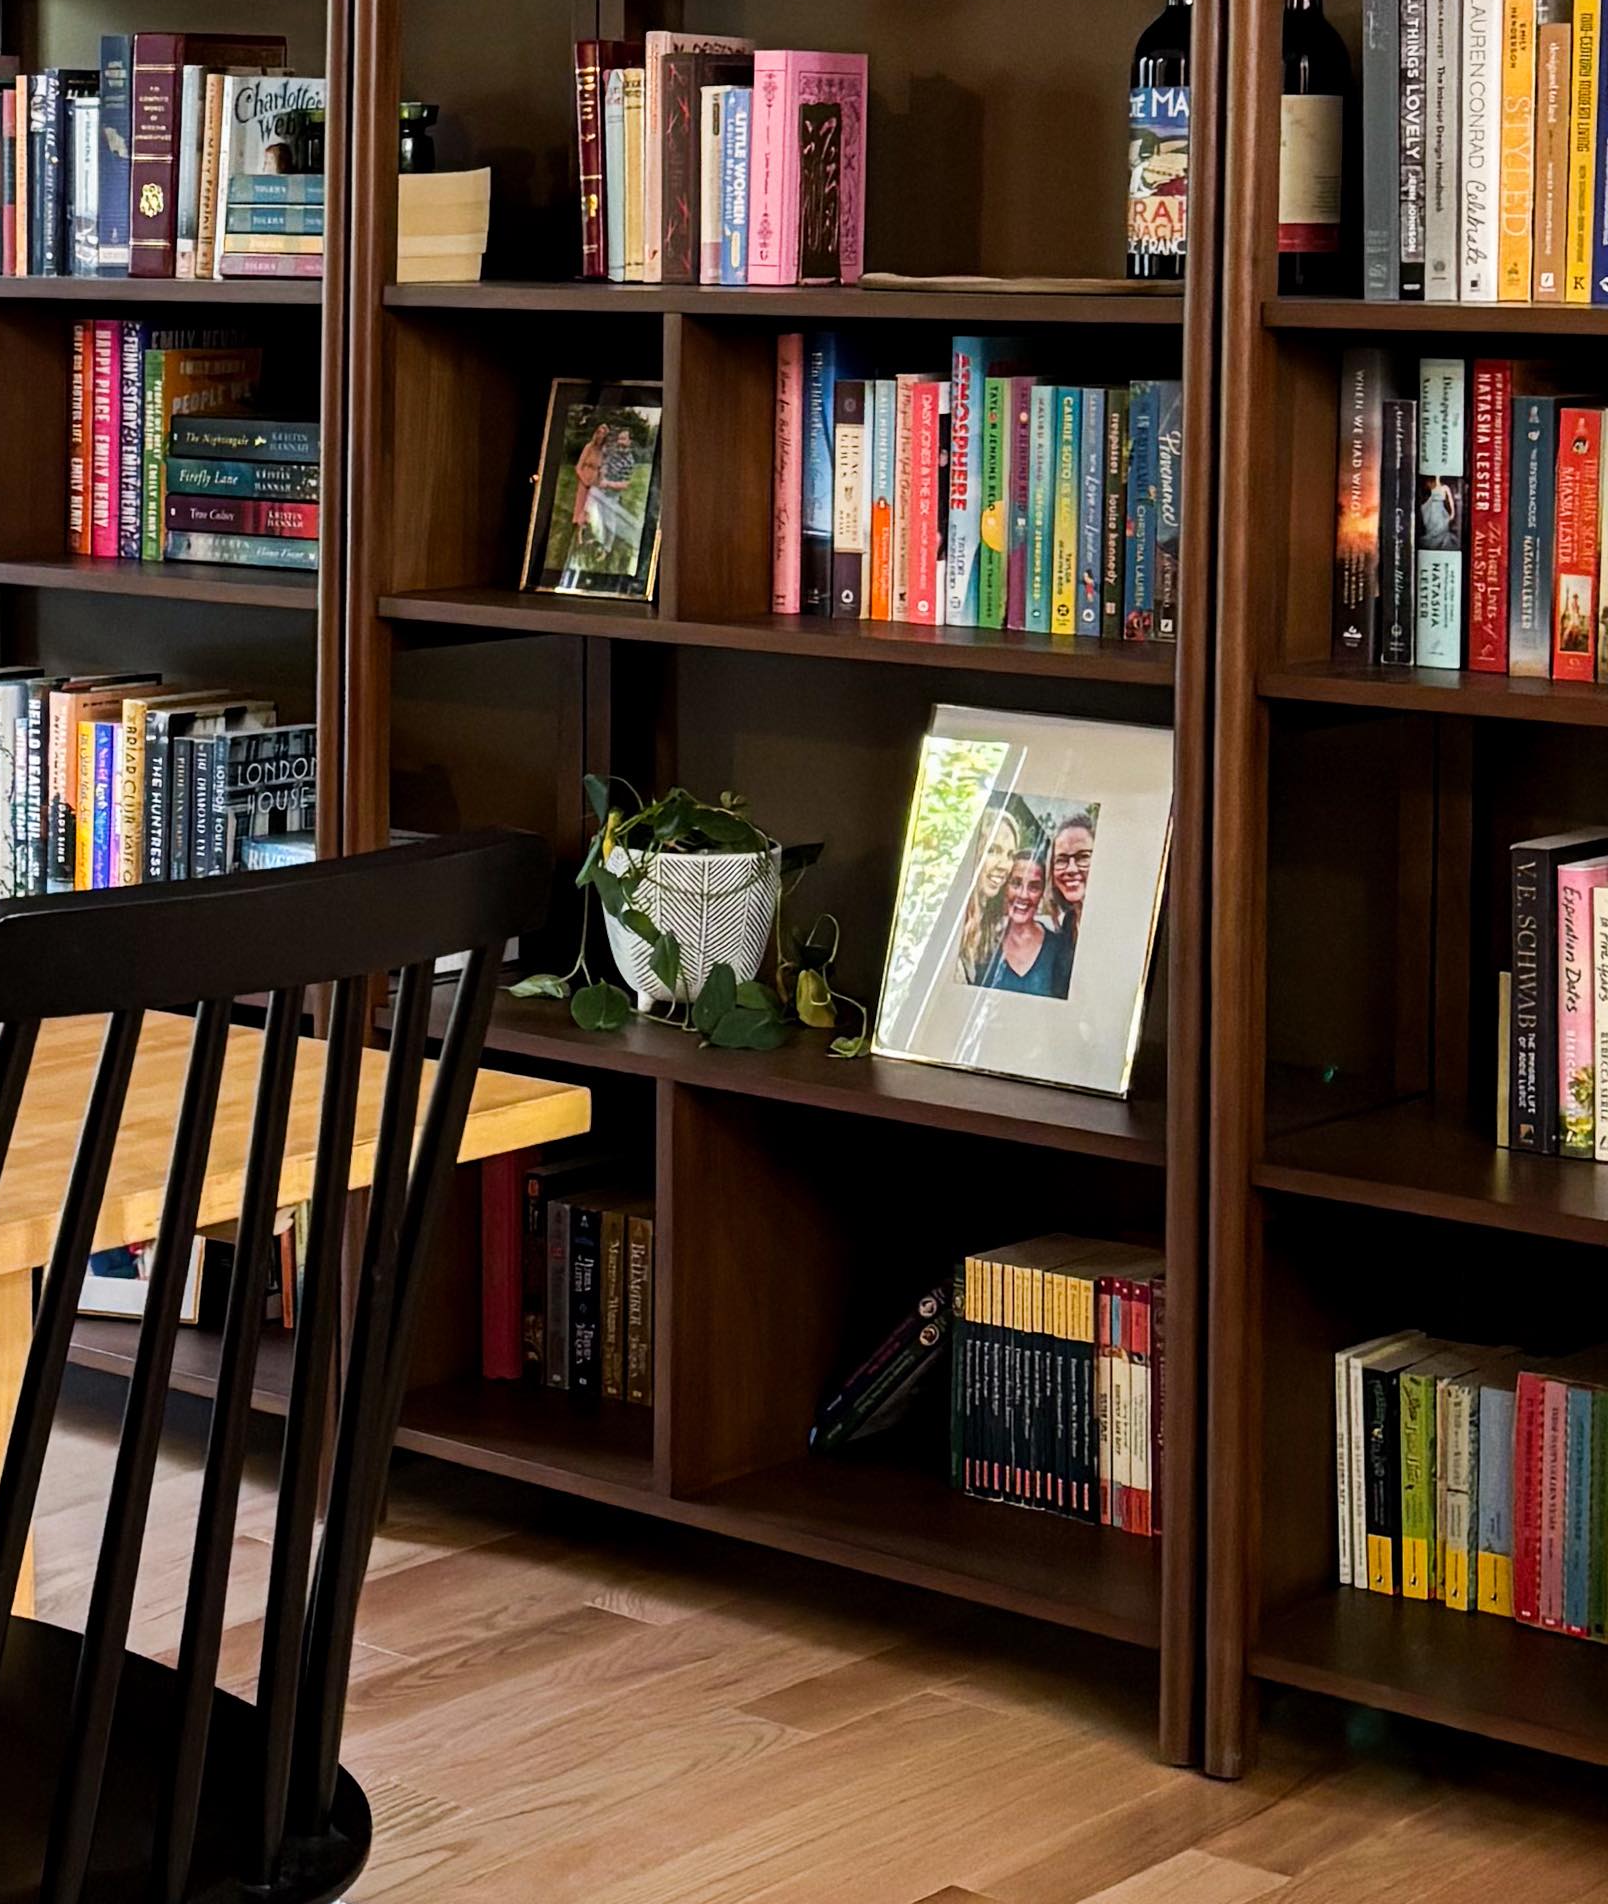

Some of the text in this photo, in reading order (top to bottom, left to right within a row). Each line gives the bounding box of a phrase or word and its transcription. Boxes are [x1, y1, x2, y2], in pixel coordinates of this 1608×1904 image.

[1406, 18, 1419, 78] THINGS
[1510, 6, 1518, 69] HENDERSON
[1519, 23, 1527, 52] EMILY
[1578, 13, 1593, 77] MID-CENTURY
[1546, 42, 1559, 123] designed to last
[1578, 80, 1592, 120] MODERN
[47, 128, 56, 146] LEE
[258, 113, 297, 142] Web
[1405, 85, 1420, 159] LOVELY
[1434, 65, 1446, 213] The Interior Design Handbook
[1468, 81, 1486, 169] CONRAD
[1577, 123, 1591, 152] LIVING
[202, 137, 214, 231] Mary Poppins
[724, 119, 735, 220] Louisa May Alcott
[734, 111, 747, 225] LITTLE WOMEN
[1502, 95, 1530, 237] STYLED
[1408, 172, 1417, 253] JENN JOHNSON
[1465, 180, 1487, 267] Celebrate
[72, 373, 83, 443] BEAUTIFUL LIFE
[95, 330, 112, 422] HAPPY PLACE
[123, 335, 139, 429] FUNNY STORY
[172, 386, 224, 414] PEOPLE
[186, 432, 249, 448] The Nightingale
[878, 419, 889, 489] HONEYMAN
[920, 394, 933, 516] DAISY JONES & THE SIX
[950, 352, 971, 511] ATMOSPHERE
[987, 386, 999, 511] TAYLOR JENKINS REID
[1036, 397, 1045, 481] MALIBU RISING
[1062, 396, 1073, 495] CARRIE SOTO IS
[1109, 413, 1119, 474] trespasses
[1350, 370, 1364, 518] WHEN WE HAD WINGS
[1439, 375, 1453, 465] Disappearance
[1475, 373, 1492, 511] NATASHA LESTER
[71, 457, 83, 533] EMILY HENRY
[93, 434, 110, 528] EMILY HENRY
[121, 445, 138, 533] EMILY HENRY
[147, 464, 158, 539] EMILY HENRY
[180, 470, 239, 487] Firefly Lane
[190, 508, 207, 520] True
[1159, 431, 1181, 527] Provenance
[1558, 466, 1574, 565] NATASHA LESTER
[1581, 459, 1597, 571] THE PARIS SECRET
[957, 535, 966, 576] TAYLOR
[1033, 488, 1044, 600] TAYLOR JENKINS REID
[1105, 494, 1120, 585] louise kennedy
[1135, 505, 1146, 562] CHRISTINA
[1134, 565, 1145, 607] LAUREN
[1419, 568, 1429, 619] LESTER
[1430, 563, 1441, 628] NATASHA
[1521, 535, 1533, 630] NATASHA LESTER
[28, 699, 41, 749] HELLO
[126, 726, 137, 774] BRIAR
[27, 756, 41, 841] BEAUTIFUL
[124, 780, 136, 824] CLUB
[150, 757, 163, 877] THE HUNTRESS
[197, 777, 207, 834] DIAMOND
[215, 765, 225, 813] LONDON
[247, 787, 310, 815] HOUSE
[57, 837, 65, 863] SING
[124, 835, 134, 865] KATE
[1516, 861, 1536, 1028] V. E. SCHWAB
[1563, 886, 1582, 1013] Expiration Dates
[1518, 1036, 1526, 1075] OF ADDIE
[1527, 1033, 1536, 1114] THE INVISIBLE LIFE
